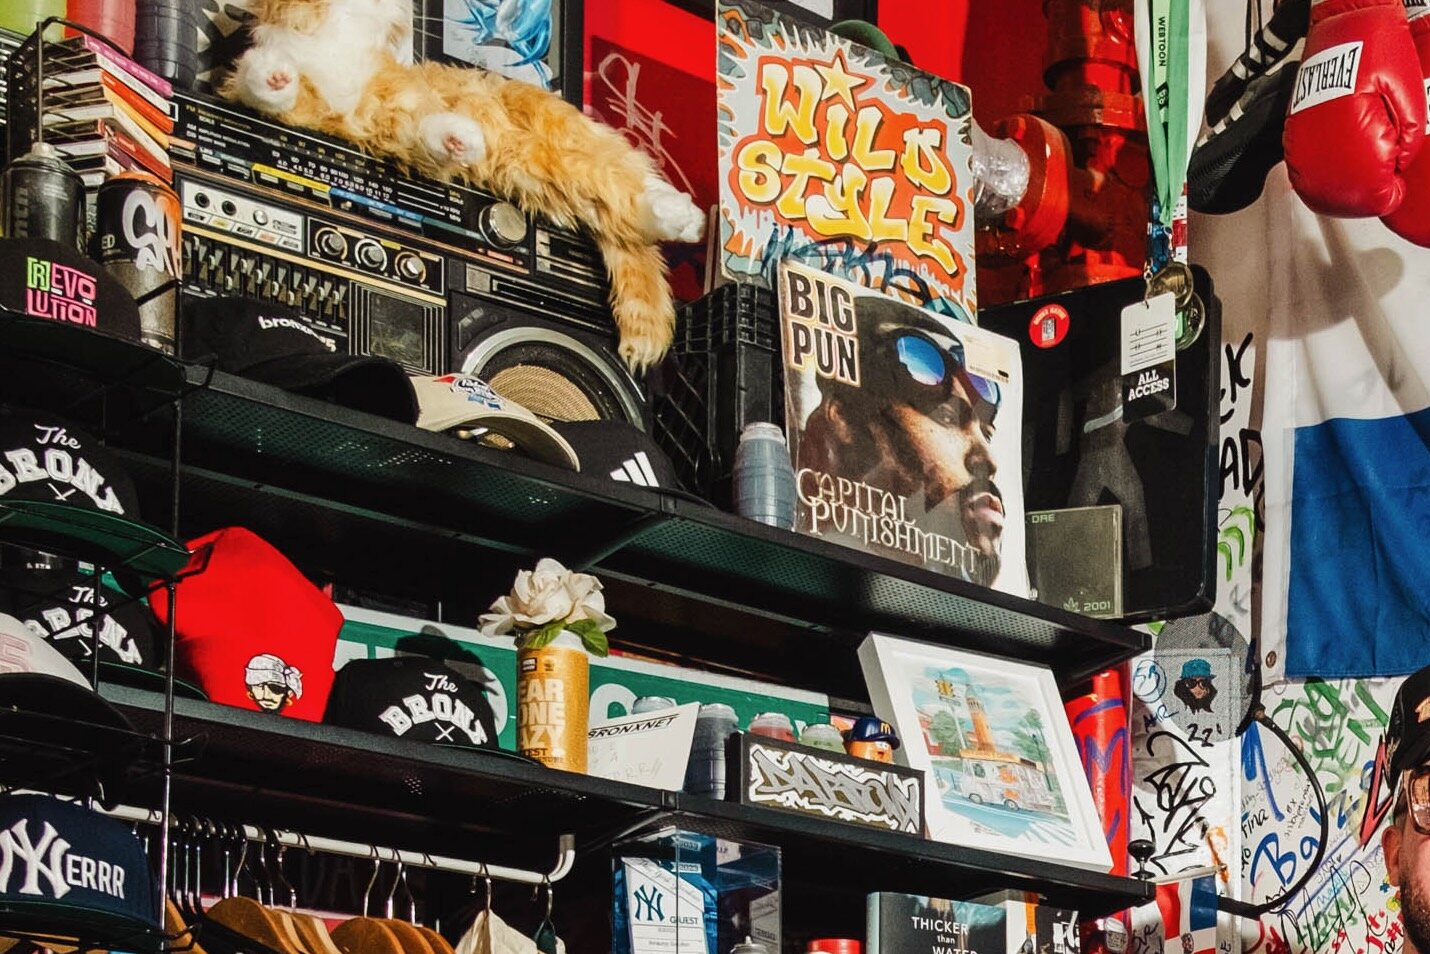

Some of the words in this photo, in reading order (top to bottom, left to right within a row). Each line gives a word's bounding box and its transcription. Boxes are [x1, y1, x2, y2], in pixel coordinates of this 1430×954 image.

[1157, 16, 1166, 67] WEBTOON
[1292, 46, 1360, 108] EVERLAST
[786, 269, 856, 333] BIG
[789, 326, 860, 388] PUN
[1127, 378, 1170, 401] ACCESS
[1138, 370, 1159, 386] ALL
[34, 424, 81, 449] The
[797, 468, 916, 526] CAPITAL
[1031, 514, 1055, 523] DRE
[808, 495, 979, 573] PUNISHMENT
[1083, 601, 1111, 613] 2001
[424, 672, 459, 693] The
[66, 864, 126, 900] ERRR
[633, 884, 665, 922] NY
[911, 916, 970, 936] THICKER
[937, 935, 956, 945] than
